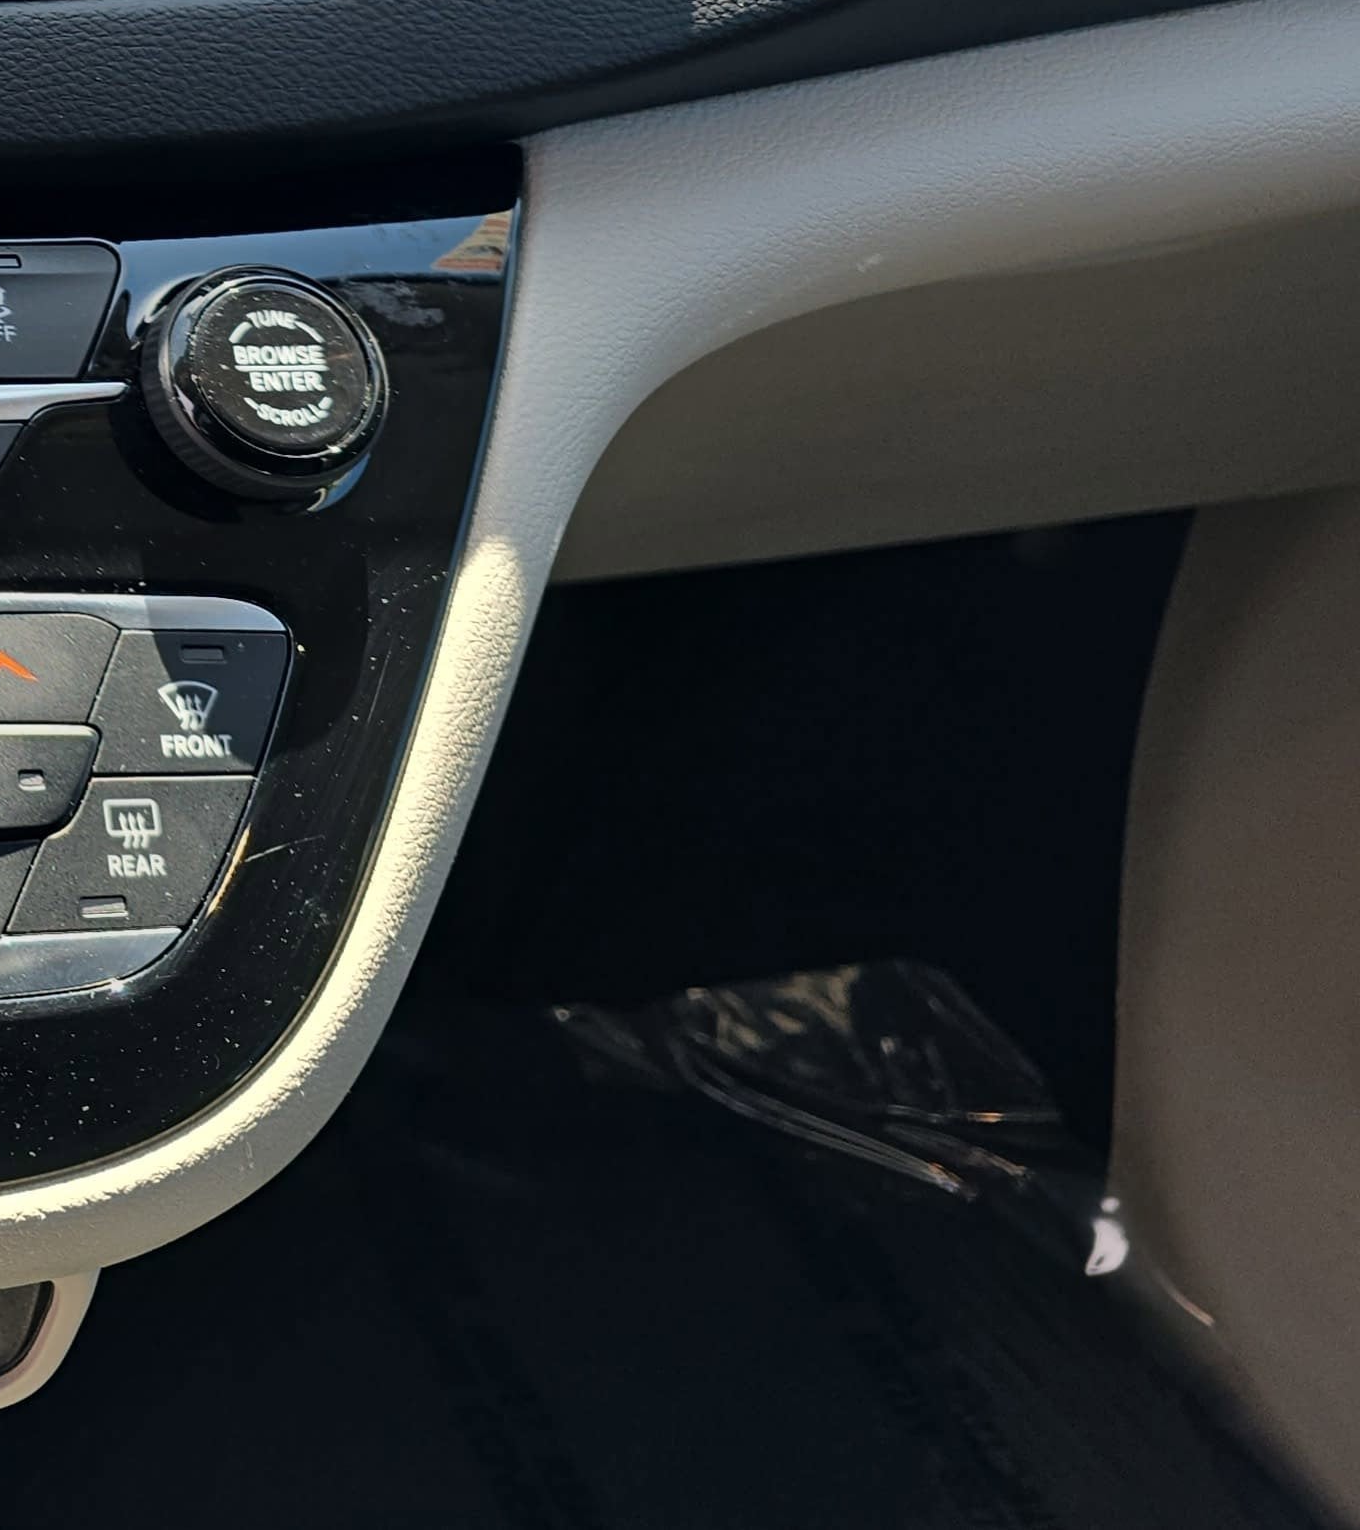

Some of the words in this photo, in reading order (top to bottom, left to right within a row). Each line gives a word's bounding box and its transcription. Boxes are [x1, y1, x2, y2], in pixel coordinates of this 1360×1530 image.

[245, 309, 299, 330] TUNE
[232, 344, 326, 365] BROWSE
[249, 370, 326, 392] ENTER
[159, 734, 231, 758] FRONT
[107, 853, 167, 878] REAR
